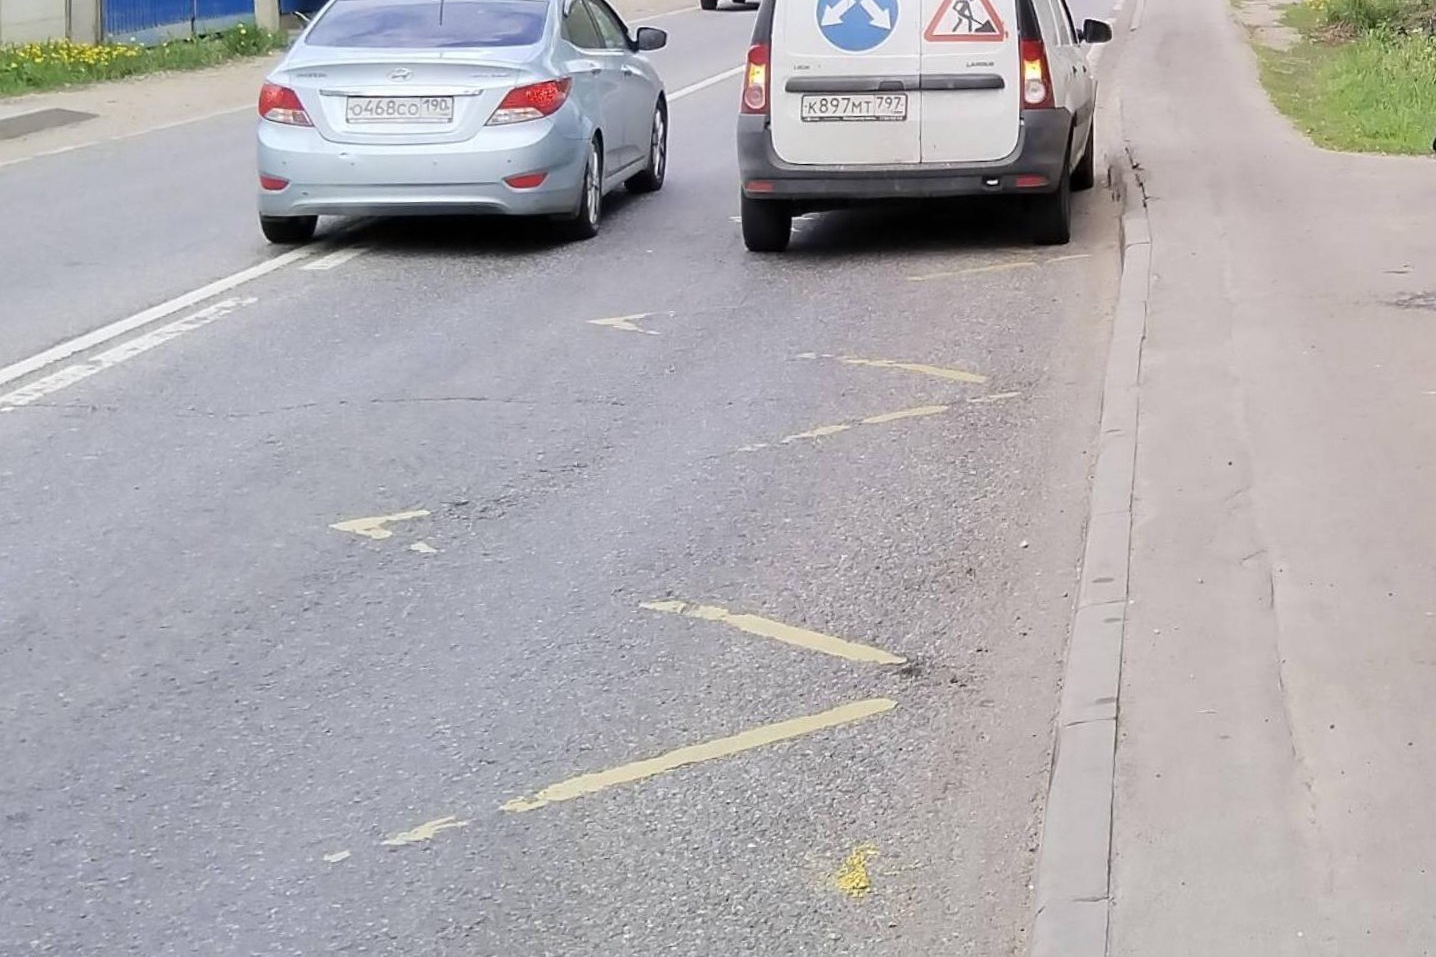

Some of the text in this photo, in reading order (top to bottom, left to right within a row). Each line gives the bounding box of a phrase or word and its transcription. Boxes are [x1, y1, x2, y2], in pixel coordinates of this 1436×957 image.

[351, 99, 448, 116] О468СО 190
[807, 97, 902, 114] К897МТ 797
